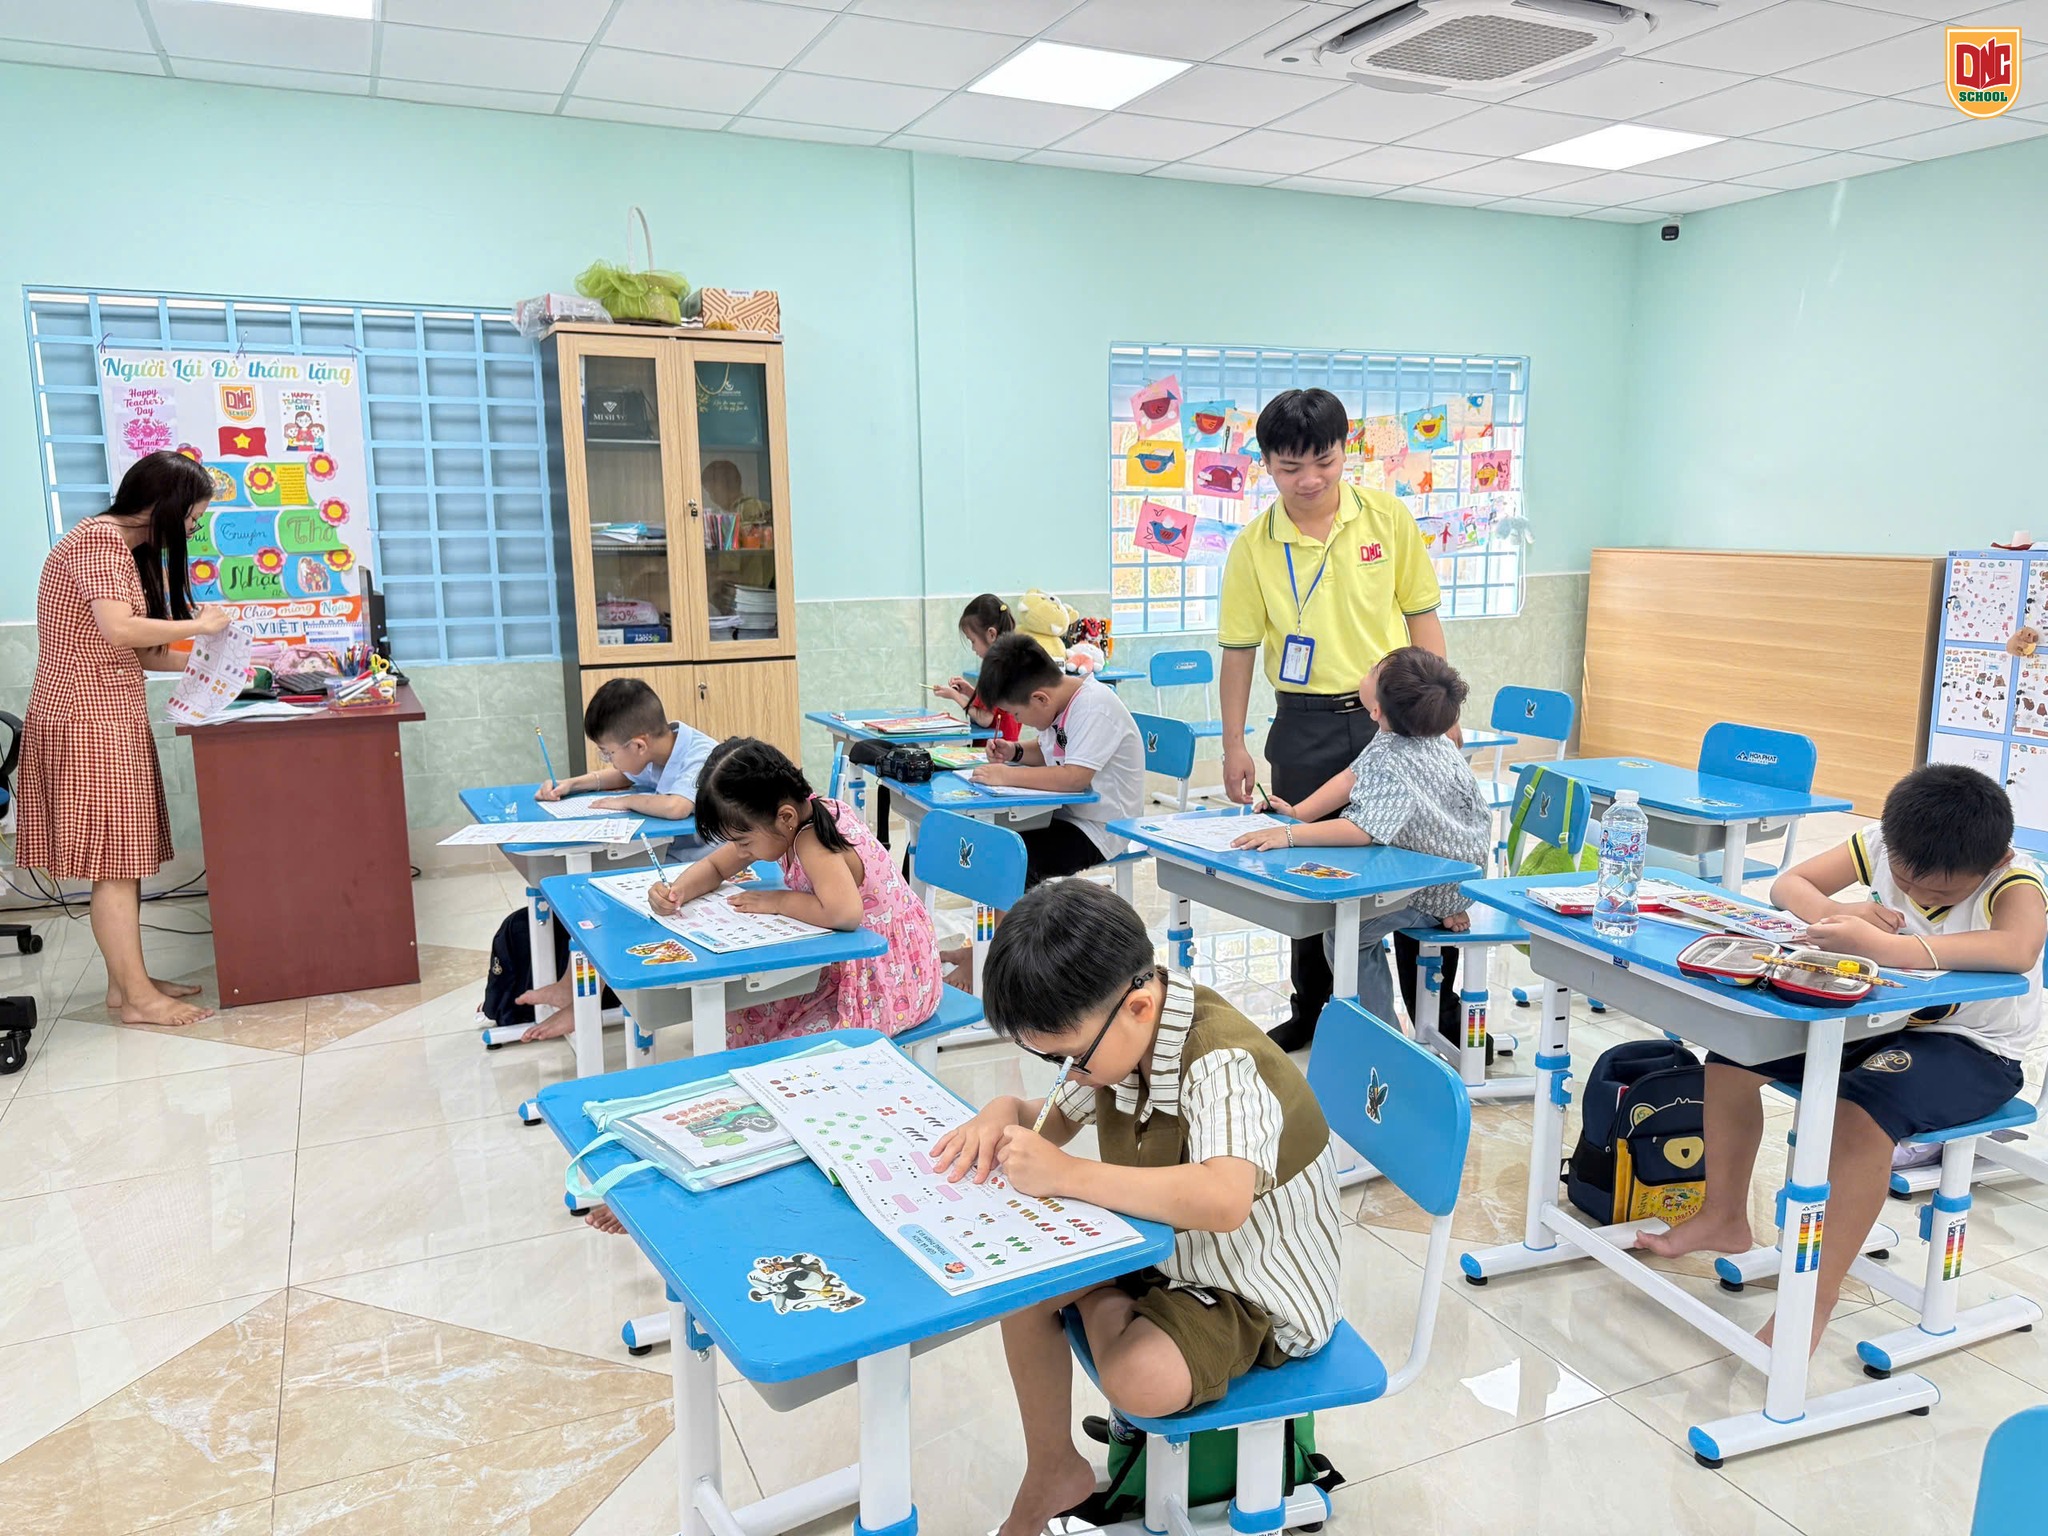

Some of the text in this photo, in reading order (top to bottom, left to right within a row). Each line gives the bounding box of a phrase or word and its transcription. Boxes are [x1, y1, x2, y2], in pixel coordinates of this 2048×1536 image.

[103, 358, 351, 385] Người Lái Đò thầm lặng
[129, 388, 158, 398] Happy
[225, 389, 251, 410] DNC
[123, 396, 164, 408] Teacher's
[135, 407, 154, 416] Day
[243, 605, 275, 619] Chào
[256, 619, 299, 636] VIỆT
